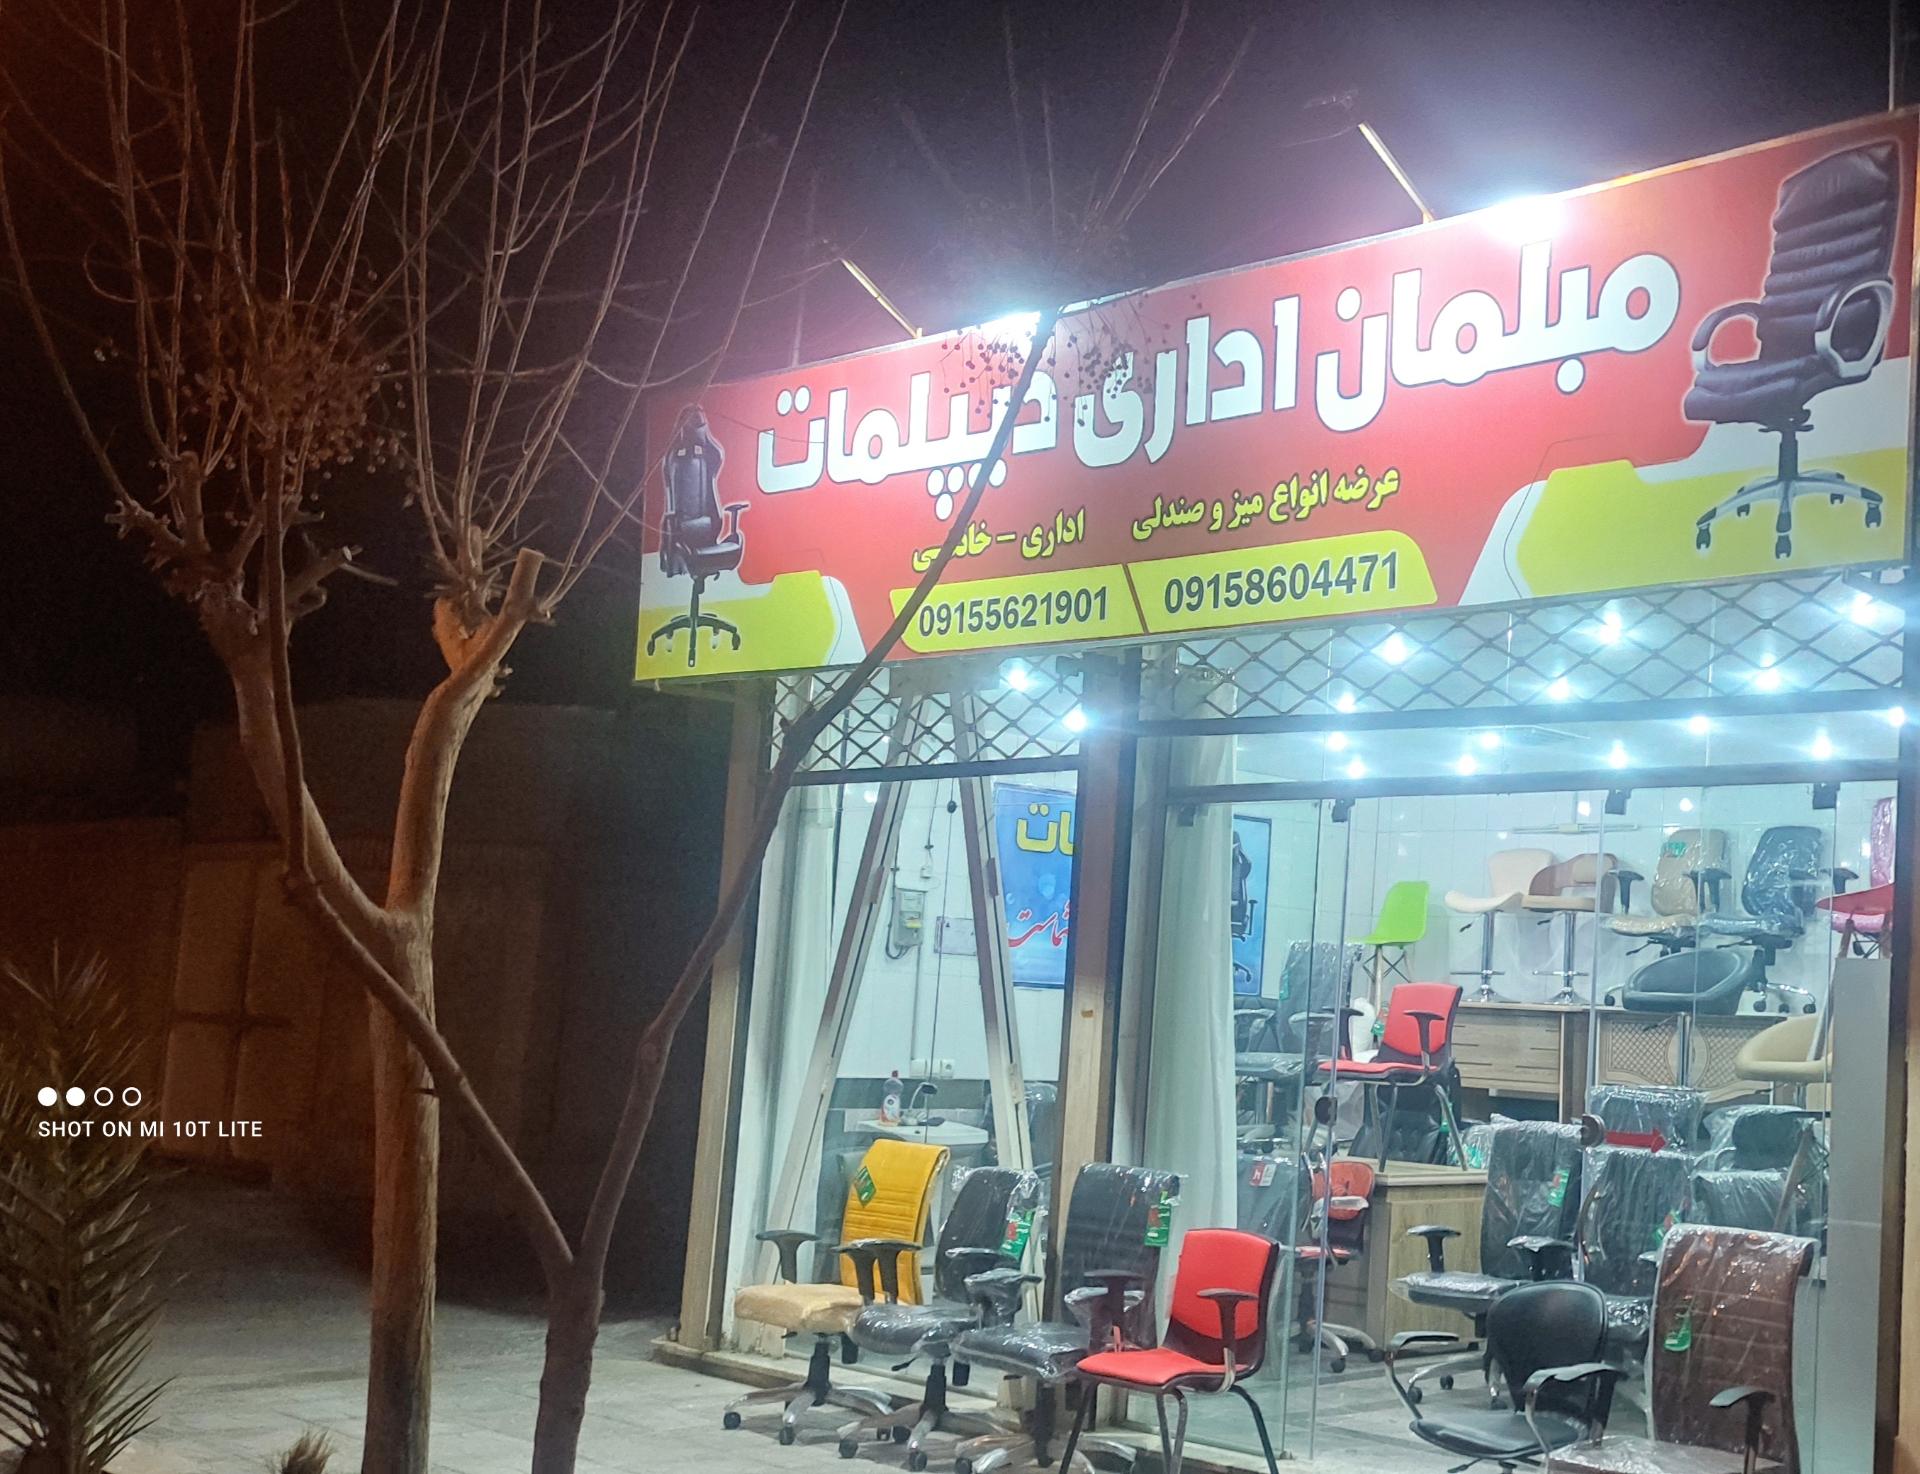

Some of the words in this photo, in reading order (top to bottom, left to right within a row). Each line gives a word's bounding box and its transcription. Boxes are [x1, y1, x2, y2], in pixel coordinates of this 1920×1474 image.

[1316, 241, 1681, 432] مبلمان
[1073, 296, 1299, 468] اداری
[756, 368, 1058, 521] دیپلمات
[1227, 490, 1264, 529] میز
[1269, 468, 1329, 523] انواع
[1333, 464, 1400, 510] عرضه
[1021, 506, 1086, 559] اداری
[1131, 496, 1205, 540] صندلی
[1208, 500, 1224, 531] و
[1164, 551, 1398, 615] 09158604471
[918, 586, 1108, 637] 09155621901
